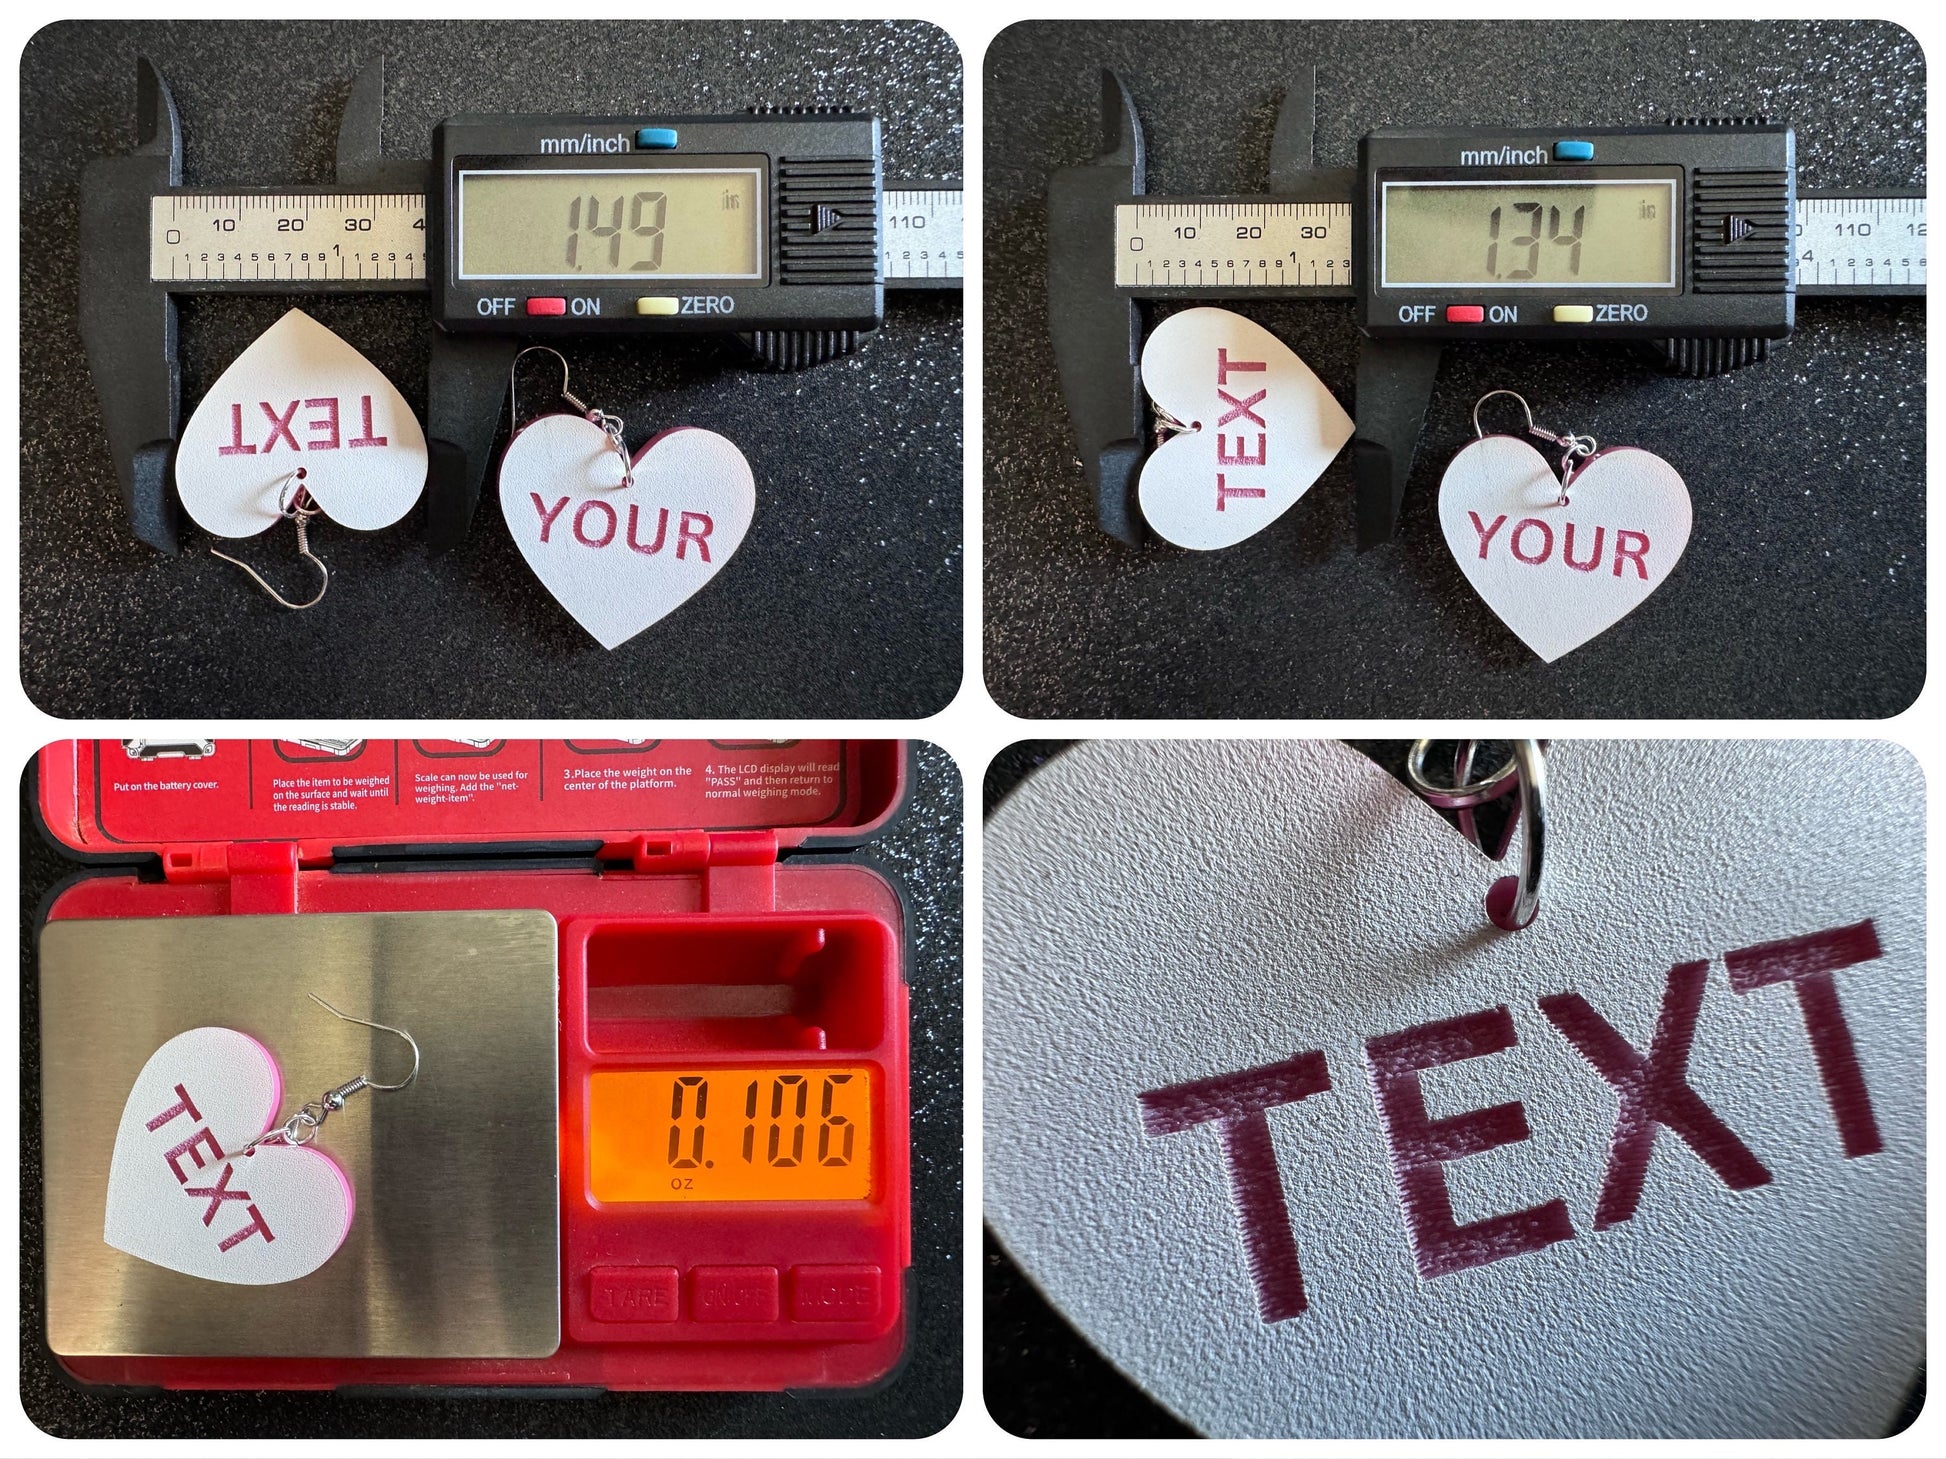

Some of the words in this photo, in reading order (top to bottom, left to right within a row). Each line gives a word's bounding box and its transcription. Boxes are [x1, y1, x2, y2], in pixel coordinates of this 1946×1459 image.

[540, 133, 630, 154] mm/inch
[1461, 145, 1548, 166] mm/inch
[890, 216, 925, 229] 110
[167, 230, 181, 244] 0
[213, 219, 235, 231] 10
[277, 219, 304, 231] 20
[344, 219, 371, 231] 30
[413, 218, 426, 231] 4
[565, 191, 667, 272] 1.49
[1835, 224, 1871, 236] 110
[1907, 224, 1927, 236] 12
[1130, 237, 1143, 251] 0
[1174, 227, 1196, 239] 10
[1236, 227, 1262, 239] 20
[1301, 226, 1327, 239] 30
[1486, 202, 1585, 280] 1.34
[184, 253, 190, 261] 1
[201, 253, 209, 261] 2
[217, 253, 225, 261] 3
[234, 253, 242, 261] 4
[251, 253, 259, 261] 5
[267, 253, 275, 261] 6
[284, 253, 292, 261] 7
[301, 253, 309, 261] 8
[318, 253, 326, 261] 9
[333, 244, 340, 257] 1
[354, 253, 360, 261] 1
[371, 253, 379, 261] 2
[388, 253, 396, 261] 3
[405, 253, 413, 261] 4
[885, 251, 890, 259] 1
[903, 251, 911, 259] 2
[920, 251, 928, 259] 3
[938, 251, 946, 259] 4
[957, 251, 963, 259] 5
[1802, 250, 1814, 262] 4
[1147, 260, 1152, 268] 1
[1163, 260, 1170, 268] 2
[1179, 260, 1186, 268] 3
[1195, 260, 1202, 268] 4
[1211, 260, 1219, 268] 5
[1227, 260, 1234, 268] 6
[1243, 260, 1250, 268] 7
[1259, 260, 1267, 268] 8
[1275, 260, 1283, 268] 9
[1289, 251, 1296, 264] 1
[1310, 260, 1315, 268] 1
[1326, 260, 1334, 268] 2
[1343, 260, 1350, 268] 3
[1830, 258, 1835, 267] 1
[1848, 258, 1856, 267] 2
[1865, 258, 1873, 267] 3
[1883, 258, 1891, 267] 4
[1902, 258, 1910, 267] 5
[477, 297, 516, 316] OFF
[571, 297, 600, 315] ON
[681, 296, 735, 314] ZERO
[1399, 305, 1436, 323] OFF
[1489, 305, 1518, 323] ON
[1596, 304, 1648, 322] ZERO
[218, 395, 387, 457] TEXT
[1216, 348, 1266, 511] TEXT
[529, 492, 714, 563] YOUR
[1468, 510, 1650, 581] YOUR
[564, 768, 601, 779] 3.Place
[603, 767, 620, 778] the
[622, 766, 657, 779] weight
[659, 768, 672, 776] on
[675, 765, 692, 776] the
[705, 765, 715, 775] 4.
[718, 764, 736, 774] The
[739, 764, 757, 774] LCD
[760, 763, 795, 775] display
[797, 762, 816, 772] will
[817, 761, 840, 772] read
[273, 779, 294, 788] Place
[297, 778, 310, 787] the
[312, 777, 330, 787] item
[333, 778, 341, 786] to
[343, 777, 353, 786] be
[355, 775, 390, 787] weighed
[415, 773, 438, 782] Scale
[458, 773, 477, 781] now
[479, 771, 490, 780] be
[492, 771, 513, 780] used
[515, 770, 528, 779] for
[705, 776, 741, 787] "PASS"
[743, 776, 762, 786] and
[764, 775, 787, 785] then
[789, 775, 821, 784] return
[823, 775, 833, 784] to
[114, 782, 129, 791] Put
[144, 782, 158, 790] the
[160, 781, 191, 791] battery
[193, 781, 219, 789] cover.
[415, 783, 458, 794] weighing.
[460, 782, 477, 791] Add
[480, 782, 494, 791] the
[496, 782, 519, 790] "net-
[564, 780, 596, 791] center
[598, 780, 608, 790] of
[610, 779, 627, 789] the
[629, 778, 677, 791] platform.
[273, 792, 284, 800] on
[286, 790, 299, 799] the
[301, 789, 330, 799] surface
[332, 789, 348, 798] and
[350, 788, 367, 798] wait
[369, 787, 389, 797] until
[415, 793, 475, 805] weight-item".
[705, 788, 740, 798] normal
[743, 786, 788, 799] weighing
[790, 786, 821, 796] mode.
[273, 802, 287, 812] the
[289, 801, 320, 813] reading
[321, 801, 329, 810] is
[330, 800, 357, 810] stable.
[667, 1074, 855, 1169] 0.106
[1137, 917, 1884, 1324] TEXT
[145, 1083, 275, 1252] TEXT
